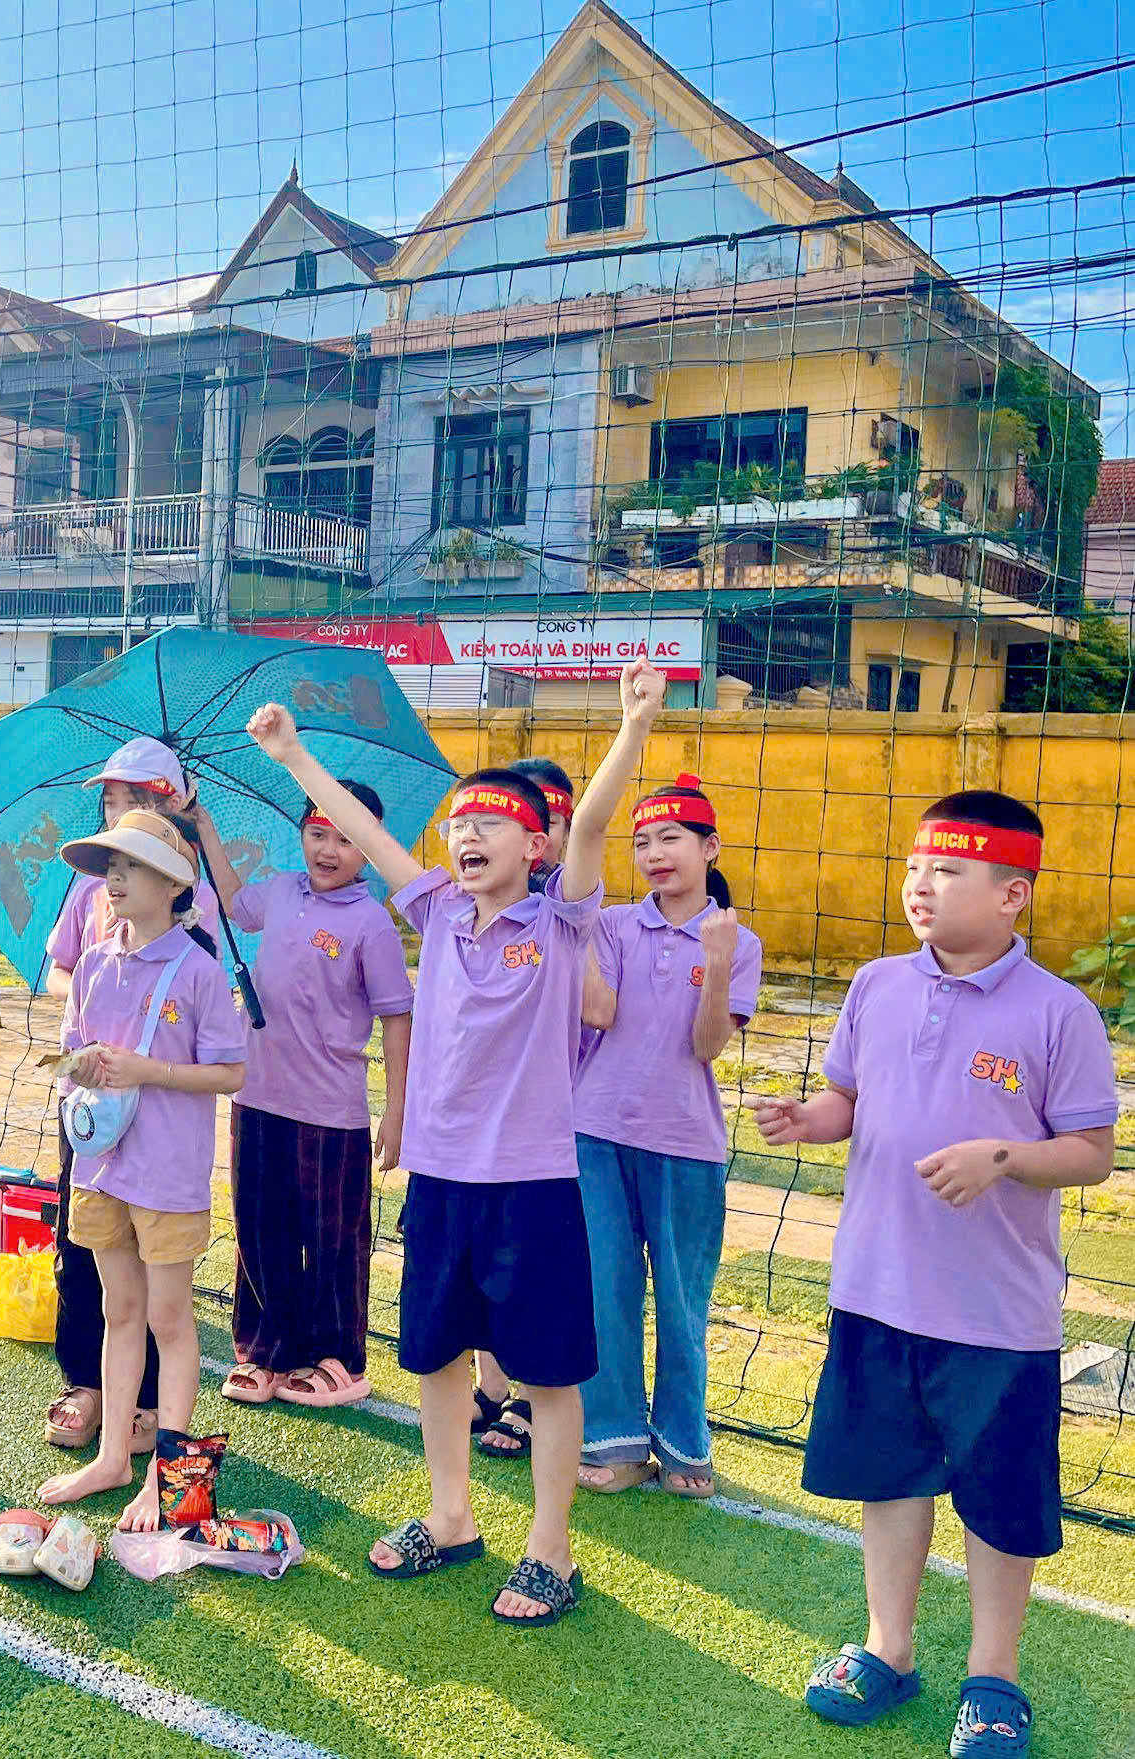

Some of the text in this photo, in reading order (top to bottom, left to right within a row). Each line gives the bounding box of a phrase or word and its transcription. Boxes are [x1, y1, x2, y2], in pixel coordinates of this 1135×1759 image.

[353, 624, 368, 636] TY
[386, 644, 408, 658] AC
[499, 639, 542, 657] TOÁN
[547, 639, 567, 657] VÀ
[571, 642, 611, 660] ĐỊNH
[616, 638, 647, 657] GIÁ
[655, 641, 681, 657] AC
[504, 939, 538, 968] 5H
[690, 965, 705, 987] 5
[969, 1051, 1019, 1083] 5H
